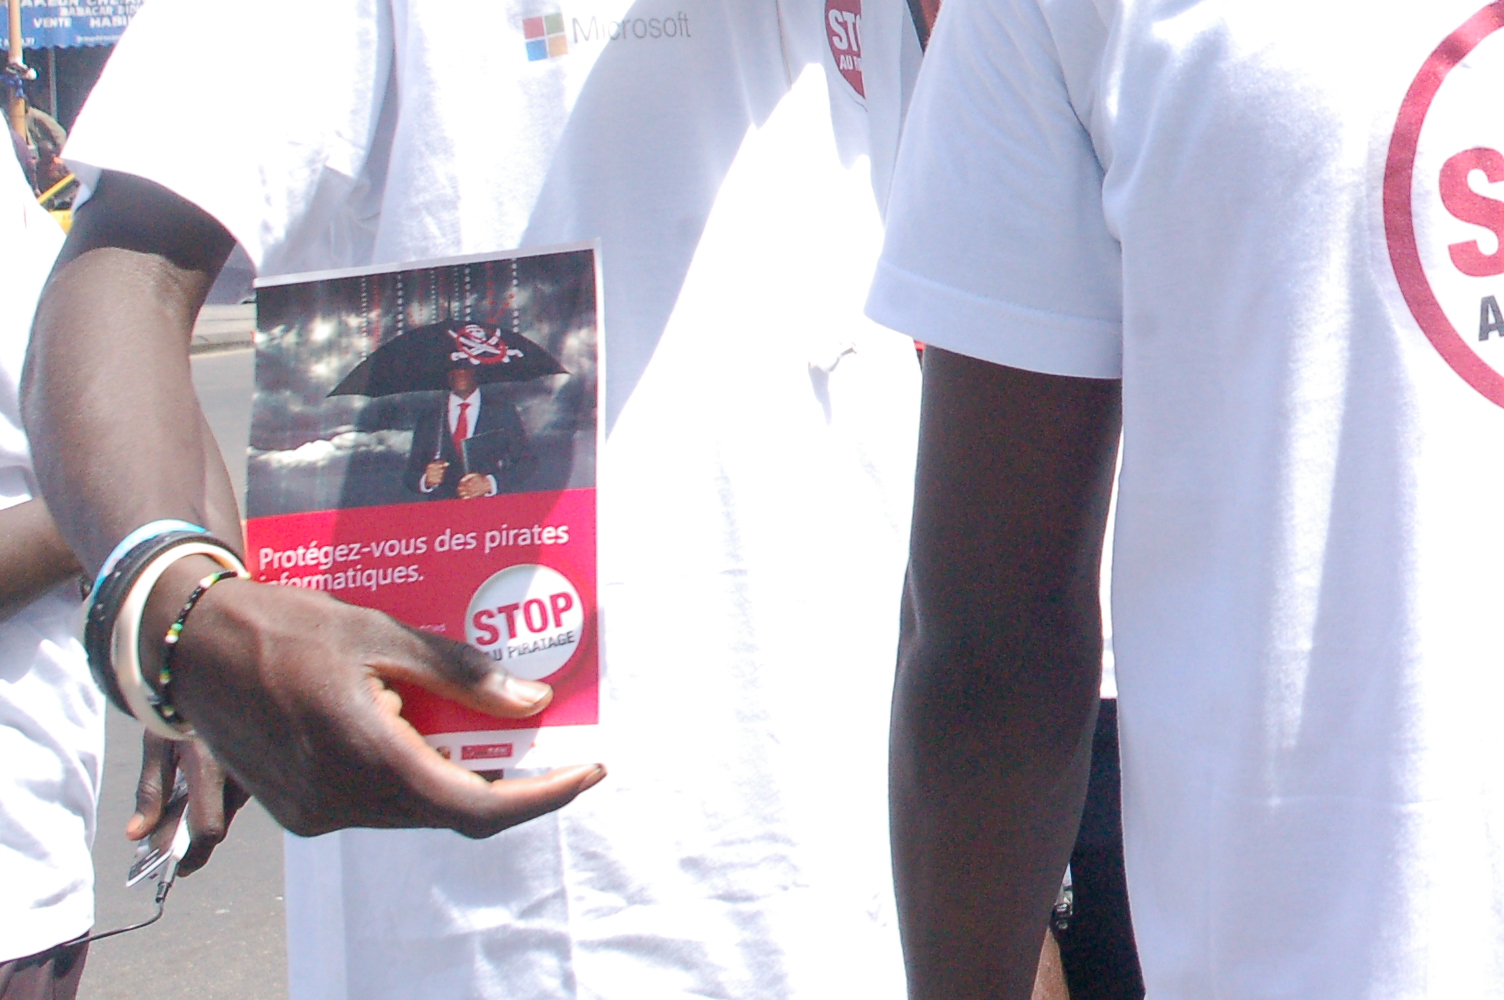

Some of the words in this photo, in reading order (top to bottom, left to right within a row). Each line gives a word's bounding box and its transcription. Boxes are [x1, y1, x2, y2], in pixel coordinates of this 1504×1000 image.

[33, 17, 72, 28] VENTE
[572, 11, 691, 43] Microsoft
[259, 538, 427, 570] Protégez-vous
[435, 528, 477, 552] des
[484, 524, 569, 554] pirates
[260, 564, 424, 591] formatiques.
[472, 591, 574, 647] STOP
[507, 630, 576, 659] PIRATAGE
